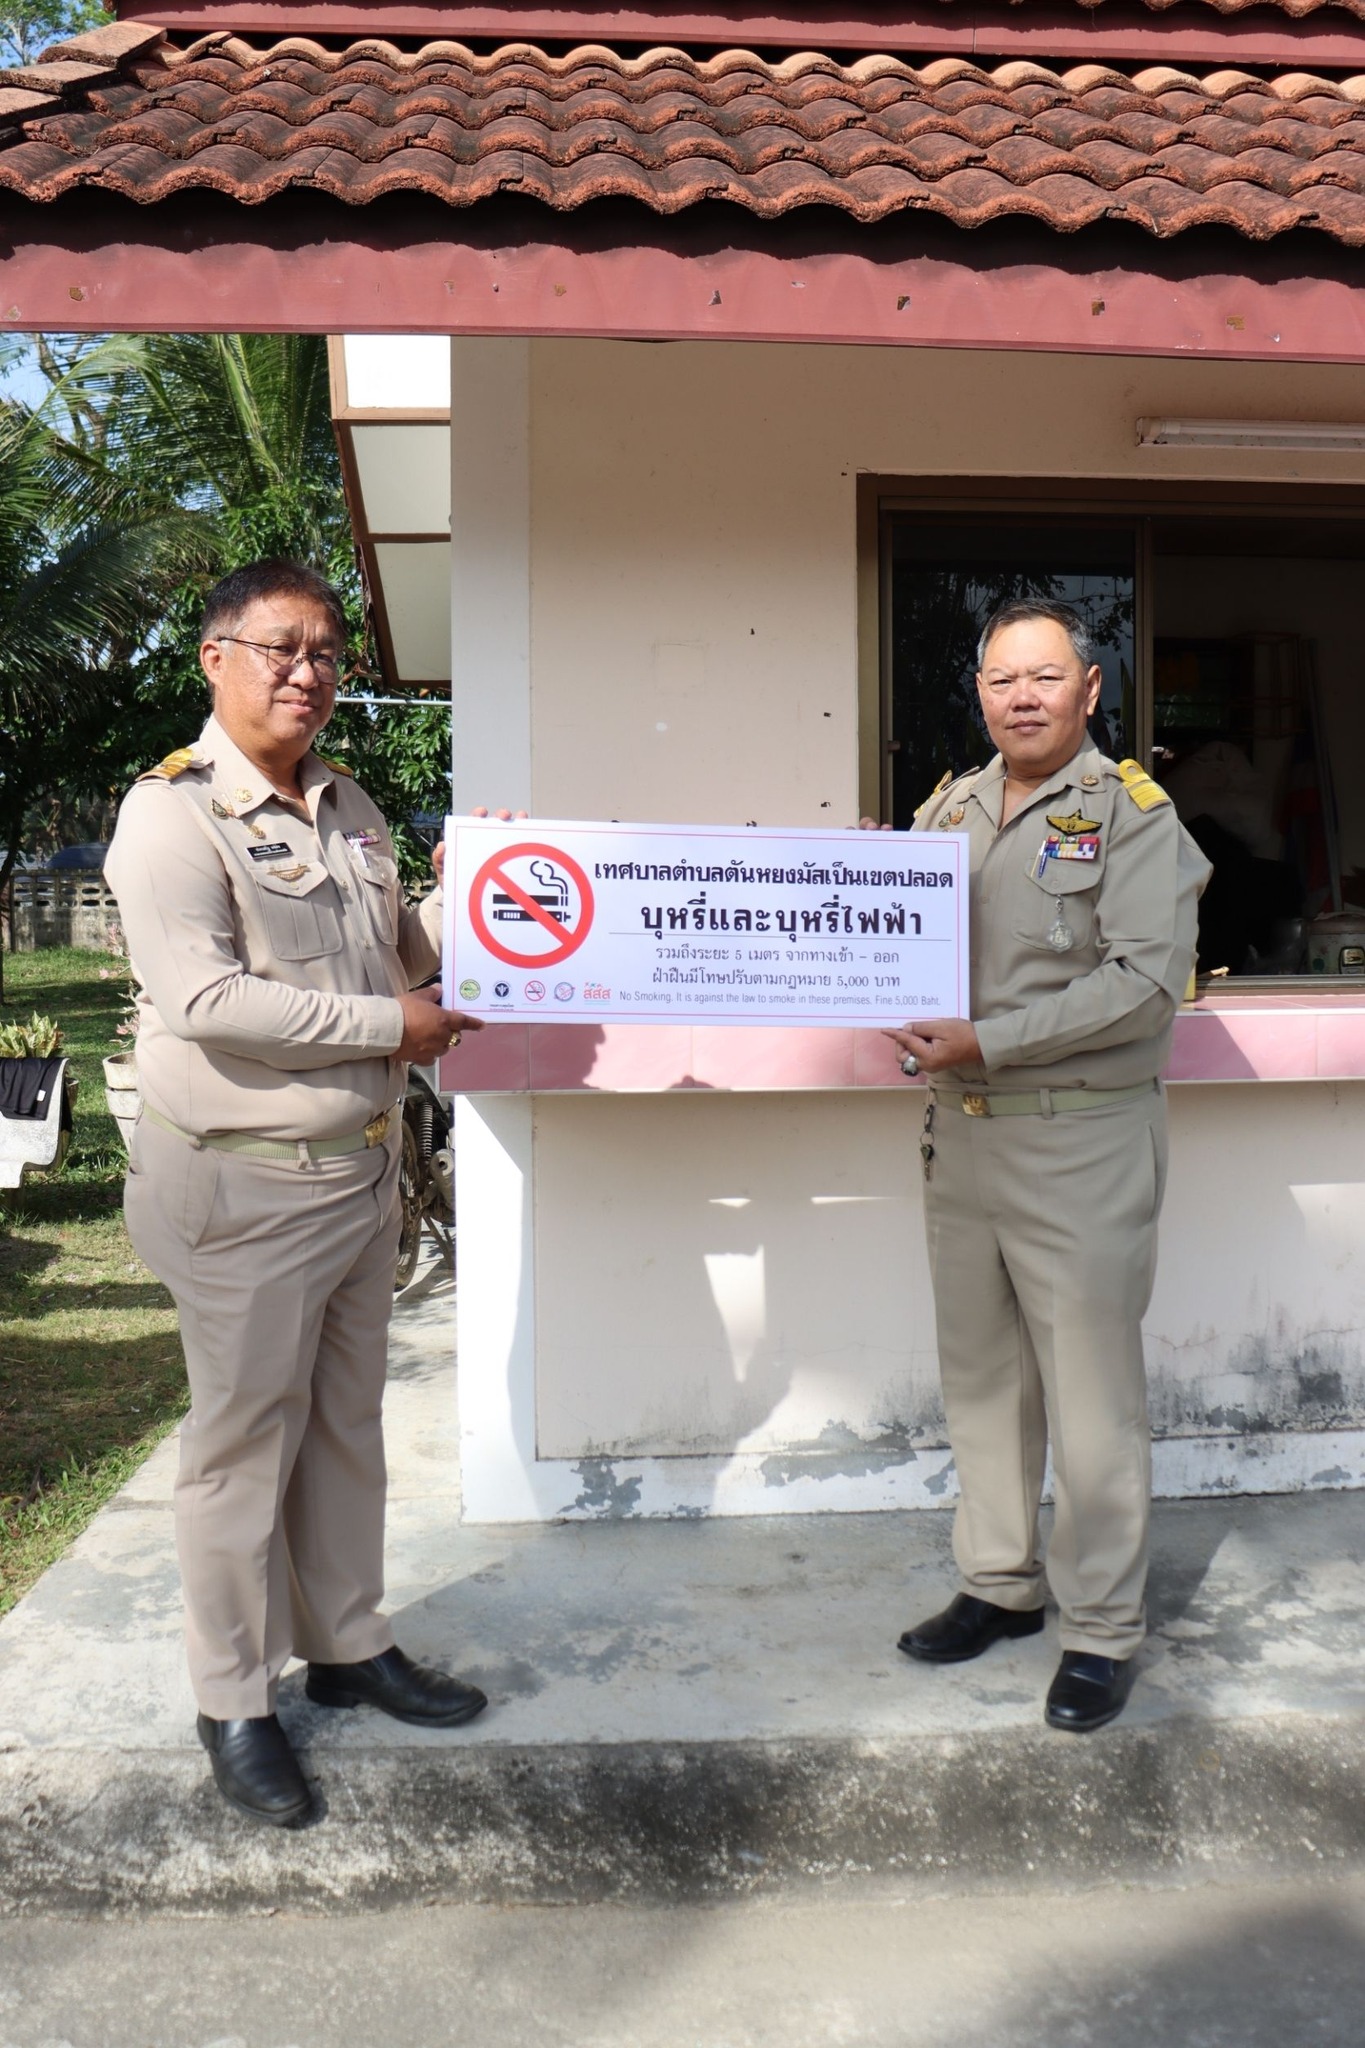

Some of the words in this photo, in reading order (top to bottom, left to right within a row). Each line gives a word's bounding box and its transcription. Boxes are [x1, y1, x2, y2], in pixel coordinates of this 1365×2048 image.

[595, 859, 953, 887] เทศบาลตำบลตันหยงมัสเป็นเขตปลอด
[641, 891, 921, 942] บุหรี่และบุหรี่ไฟฟ้า
[656, 943, 729, 960] รวมถึงระยะ
[735, 950, 742, 960] 5
[748, 950, 780, 961] เมตร
[786, 946, 854, 962] จากทางเข้า
[874, 952, 899, 963] ออก
[837, 975, 869, 989] 5,000
[875, 976, 900, 987] บาท
[619, 991, 631, 1001] No
[634, 991, 673, 1004] Smoking.
[676, 992, 682, 1002] It
[685, 992, 692, 1002] is
[694, 992, 724, 1004] against
[726, 993, 739, 1003] the
[742, 993, 755, 1003] law
[757, 993, 766, 1003] to
[768, 994, 795, 1003] smoke
[798, 994, 806, 1004] in
[808, 994, 831, 1004] these
[833, 995, 872, 1006] premises.
[875, 995, 893, 1005] Fine
[895, 995, 919, 1006] 5,000
[921, 996, 941, 1006] Baht.
